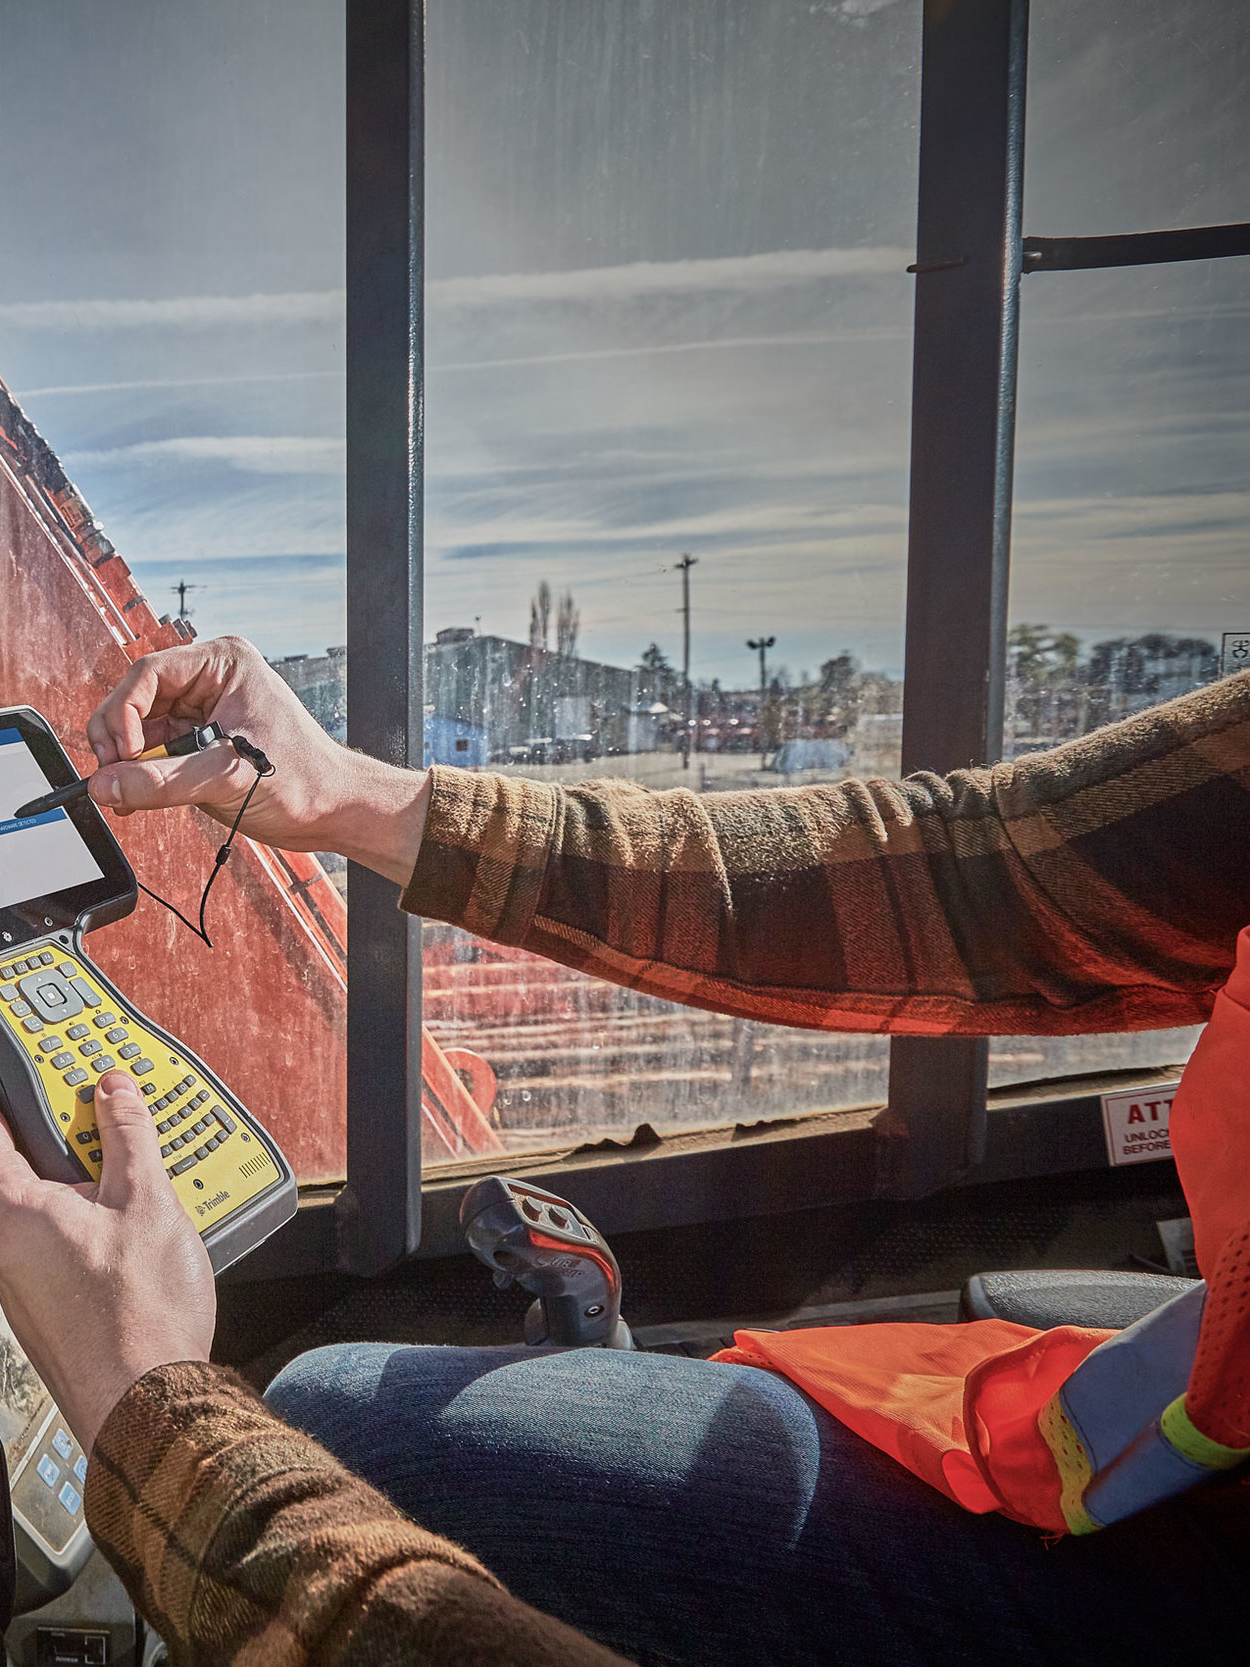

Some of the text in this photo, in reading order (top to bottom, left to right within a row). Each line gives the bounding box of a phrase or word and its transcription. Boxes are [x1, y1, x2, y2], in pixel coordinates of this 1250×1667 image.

[1127, 1099, 1174, 1124] AT
[1123, 1140, 1171, 1155] BEFORE
[202, 1191, 231, 1211] Trimble
